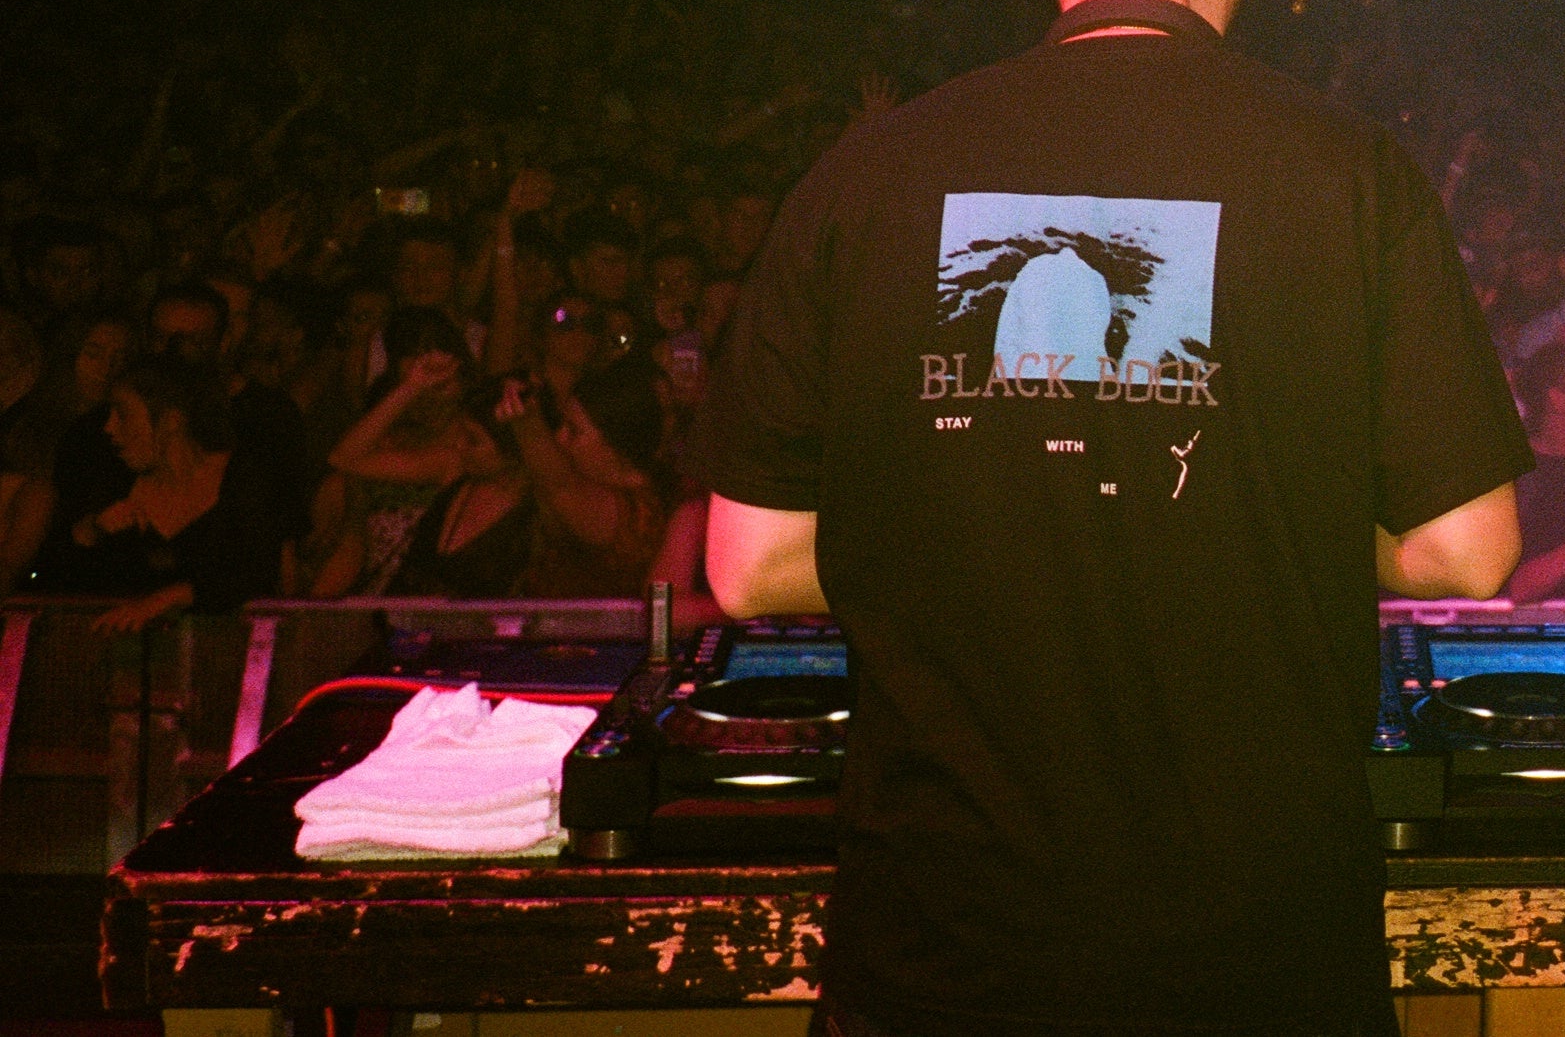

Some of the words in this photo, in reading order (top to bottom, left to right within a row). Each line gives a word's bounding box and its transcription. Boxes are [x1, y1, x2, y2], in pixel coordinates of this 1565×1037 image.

[919, 353, 1075, 400] BLACK
[935, 417, 972, 430] STAY
[1046, 440, 1085, 453] WITH
[1100, 482, 1118, 495] ME
